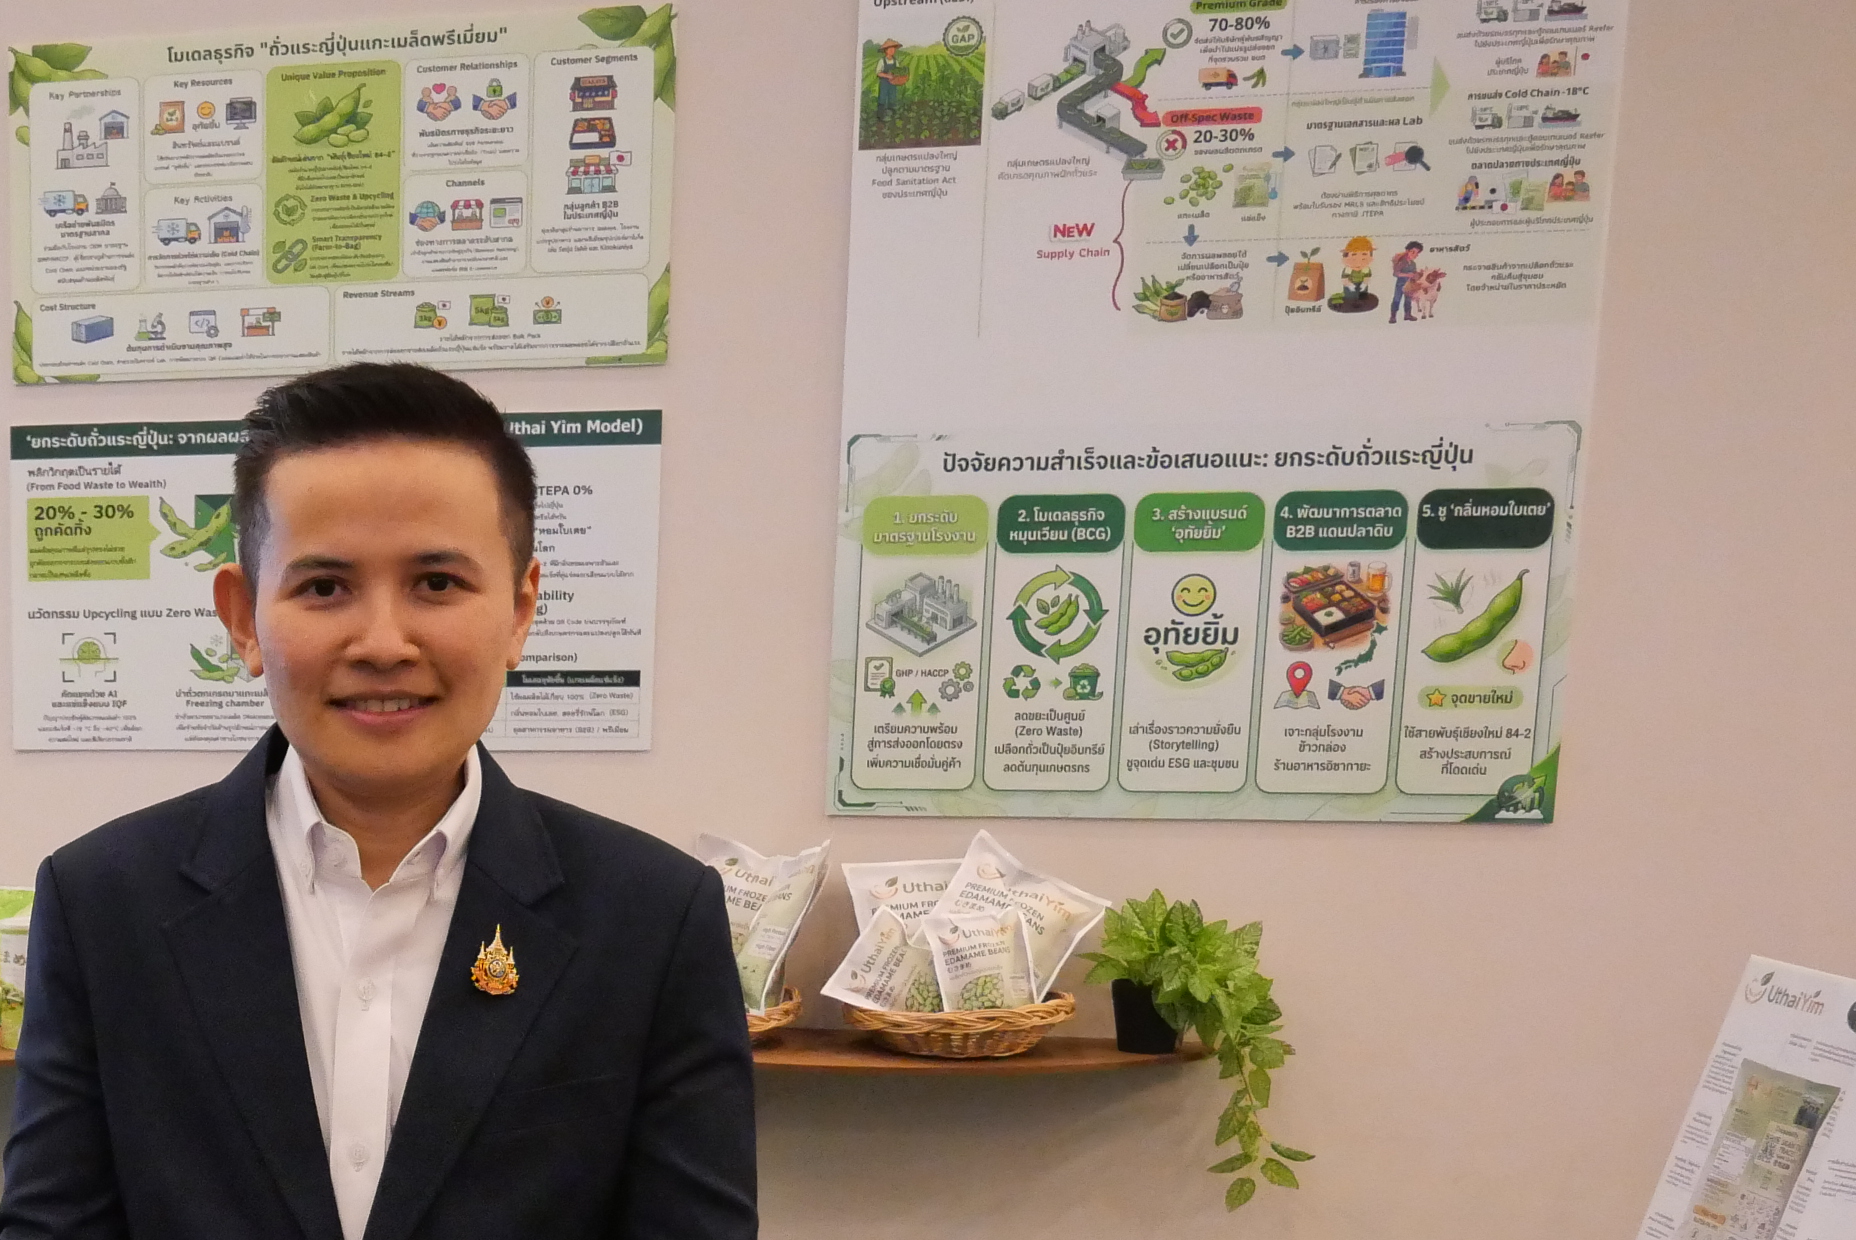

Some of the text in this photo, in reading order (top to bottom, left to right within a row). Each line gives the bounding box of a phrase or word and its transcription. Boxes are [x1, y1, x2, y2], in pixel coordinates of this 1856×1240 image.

[1196, 0, 1247, 10] Premium
[1208, 16, 1270, 32] 70-80%
[951, 34, 975, 44] GAP
[167, 45, 255, 65] โมเดลธุรกิจ
[550, 53, 638, 67] Customer Segments
[416, 60, 518, 74] Customer Relationships
[281, 72, 310, 83] Unique
[338, 67, 386, 80] Proposition
[173, 77, 233, 90] Key Resources
[49, 88, 122, 101] Key Partnerships
[1505, 89, 1528, 99] Cold
[1530, 88, 1560, 97] Chain
[1219, 112, 1254, 121] Waste
[1402, 116, 1423, 126] Lab
[1193, 128, 1255, 143] 20-30%
[446, 178, 485, 188] Channels
[872, 176, 957, 187] Food Sanitation Act
[173, 194, 233, 207] Key Activities
[1053, 223, 1095, 238] NEW
[1036, 247, 1110, 260] Supply Chain
[343, 288, 415, 300] Revenue Streams
[39, 302, 96, 313] Cost Structure
[550, 418, 643, 435] Yim Model)
[943, 436, 1474, 472] ปัจจัยความสำเร็จและข้อเสนอแนะ: ยกระดับถั่วแระญี่ปุ่น
[26, 479, 167, 493] (From Food Waste to Wealth)
[573, 485, 593, 495] 0%
[35, 503, 134, 521] 20% 30%
[894, 510, 958, 524] 1. ยกระดับ
[1018, 506, 1106, 527] 2. โมเดลธุรกิจ
[1152, 504, 1248, 521] 3. สร้างแบรนด์
[1280, 504, 1402, 519] 4. พัฒนาการตลาด
[1422, 498, 1552, 522] 5. ชู ‘กลิ่นหอมใบเตย’
[35, 520, 92, 541] ถูกคัดทิ้ง
[1009, 526, 1111, 546] หมุนเวียน (BCG)
[1171, 521, 1227, 544] ‘อุทัยยิ้ม’
[1286, 522, 1394, 539] B2B แดนปลาดิบ
[874, 530, 976, 547] มาตรฐานโรงงาน
[28, 607, 191, 620] นวัตกรรม Upcycling แบบ Zero
[1143, 613, 1239, 655] อุทัยยิ้ม
[895, 668, 950, 678] GHP HACCP
[185, 699, 264, 709] Freezing chamber
[1451, 690, 1514, 708] จุดขายใหม่
[1014, 709, 1086, 726] ลดขยะเป็นศูนย์
[874, 722, 958, 735] เตรียมความพร้อม
[1014, 726, 1084, 738] (Zero Waste)
[1128, 719, 1242, 737] เล่าเรื่องราวความยั่งยืน
[1284, 725, 1364, 741] เจาะกลุ่มโรงงาน
[1404, 726, 1531, 744] ใช้สายพันธุ์เชียงใหม่ 84-2
[867, 736, 964, 753] สู่การส่งออกโดยตรง
[994, 739, 1106, 756] เปลือกถั่วเป็นปุ๋ยอินทรีย์
[1148, 739, 1220, 752] (Storytelling)
[1298, 740, 1347, 754] ข้าวกล่อง
[1419, 747, 1513, 761] สร้างประสบการณ์
[866, 754, 962, 773] เพิ่มความเชื่อมั่นคู่ค้า
[1002, 761, 1091, 776] ลดต้นทุนเกษตรกร
[1126, 757, 1239, 773] ชูจุดเด่น ESG และชุมชน
[1274, 758, 1372, 772] ร้านอาหารอิซากายะ
[1441, 761, 1487, 776] ที่โดดเด่น
[965, 882, 1009, 900] PREMIUM
[943, 944, 977, 957] PREMIUM
[945, 951, 986, 966] EDAMAME
[1767, 985, 1825, 1016] UthaiYim
